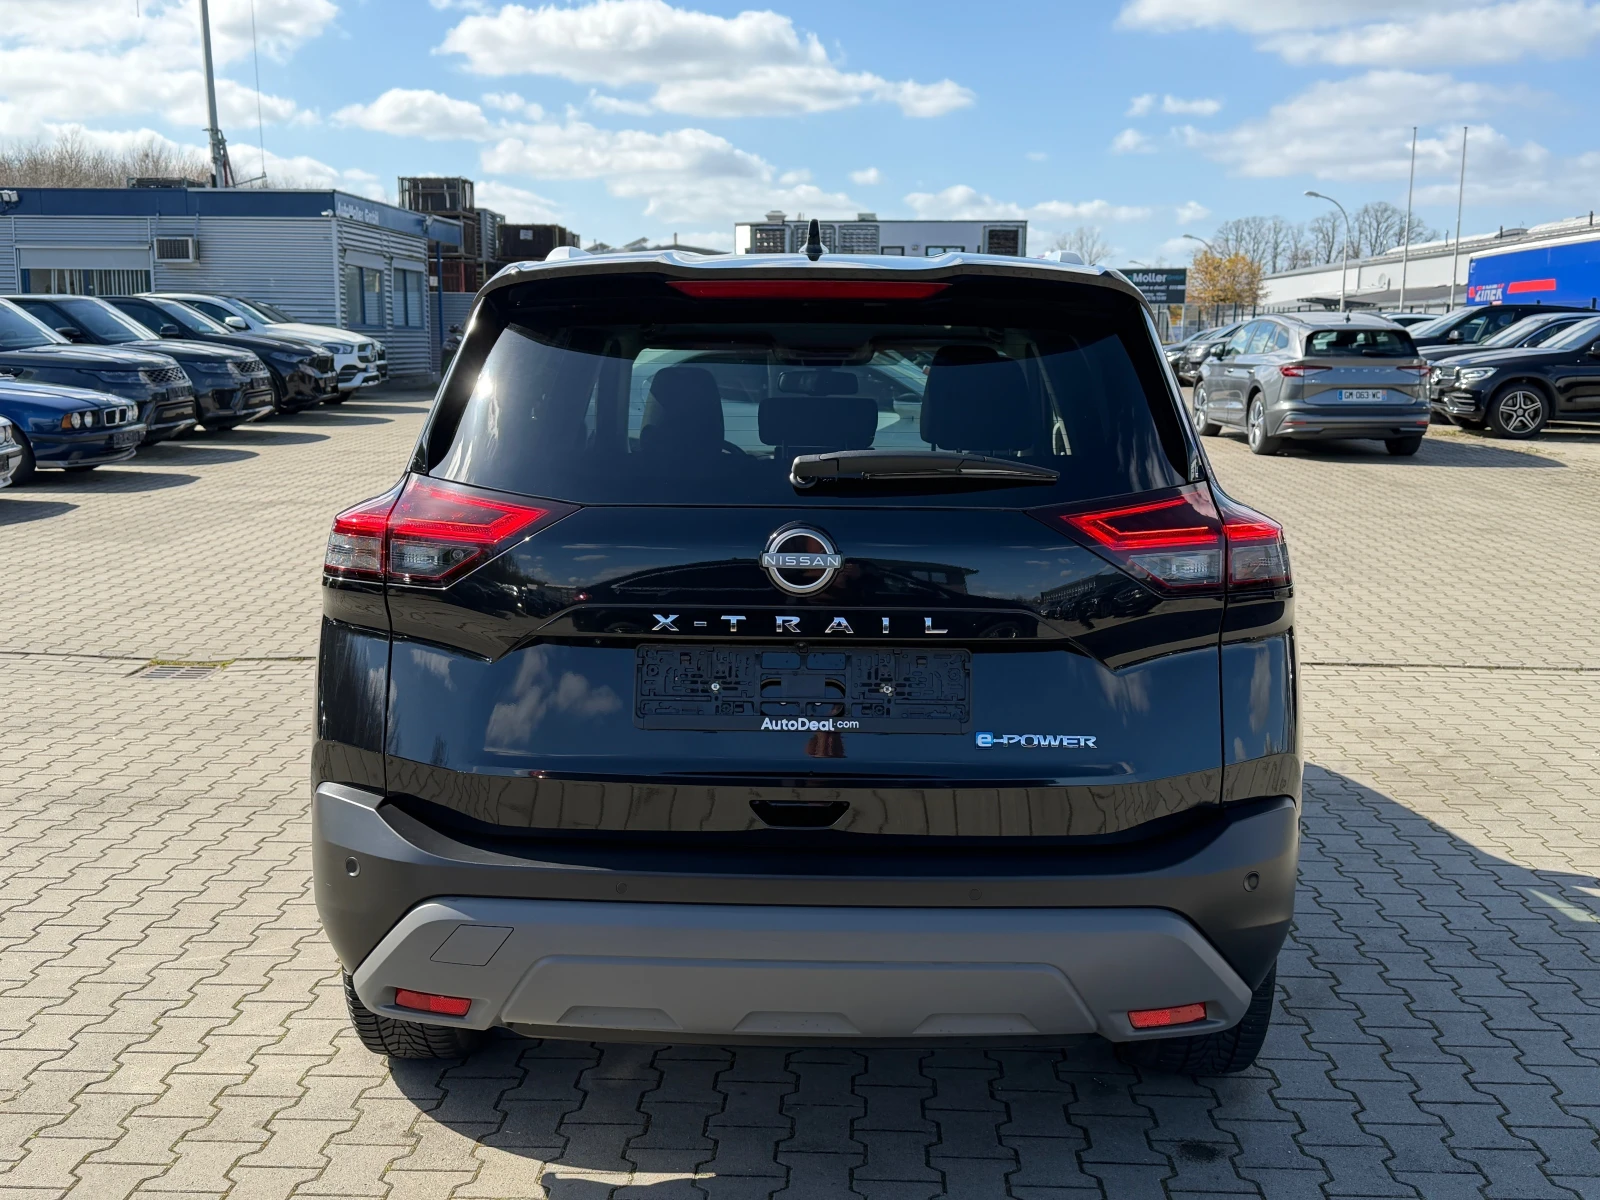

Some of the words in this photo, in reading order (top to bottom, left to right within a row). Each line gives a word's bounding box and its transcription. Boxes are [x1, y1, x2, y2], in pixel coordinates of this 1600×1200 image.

[764, 555, 840, 567] NISSAN
[651, 613, 949, 634] X-TRAIL
[976, 732, 1098, 749] e-POWER
